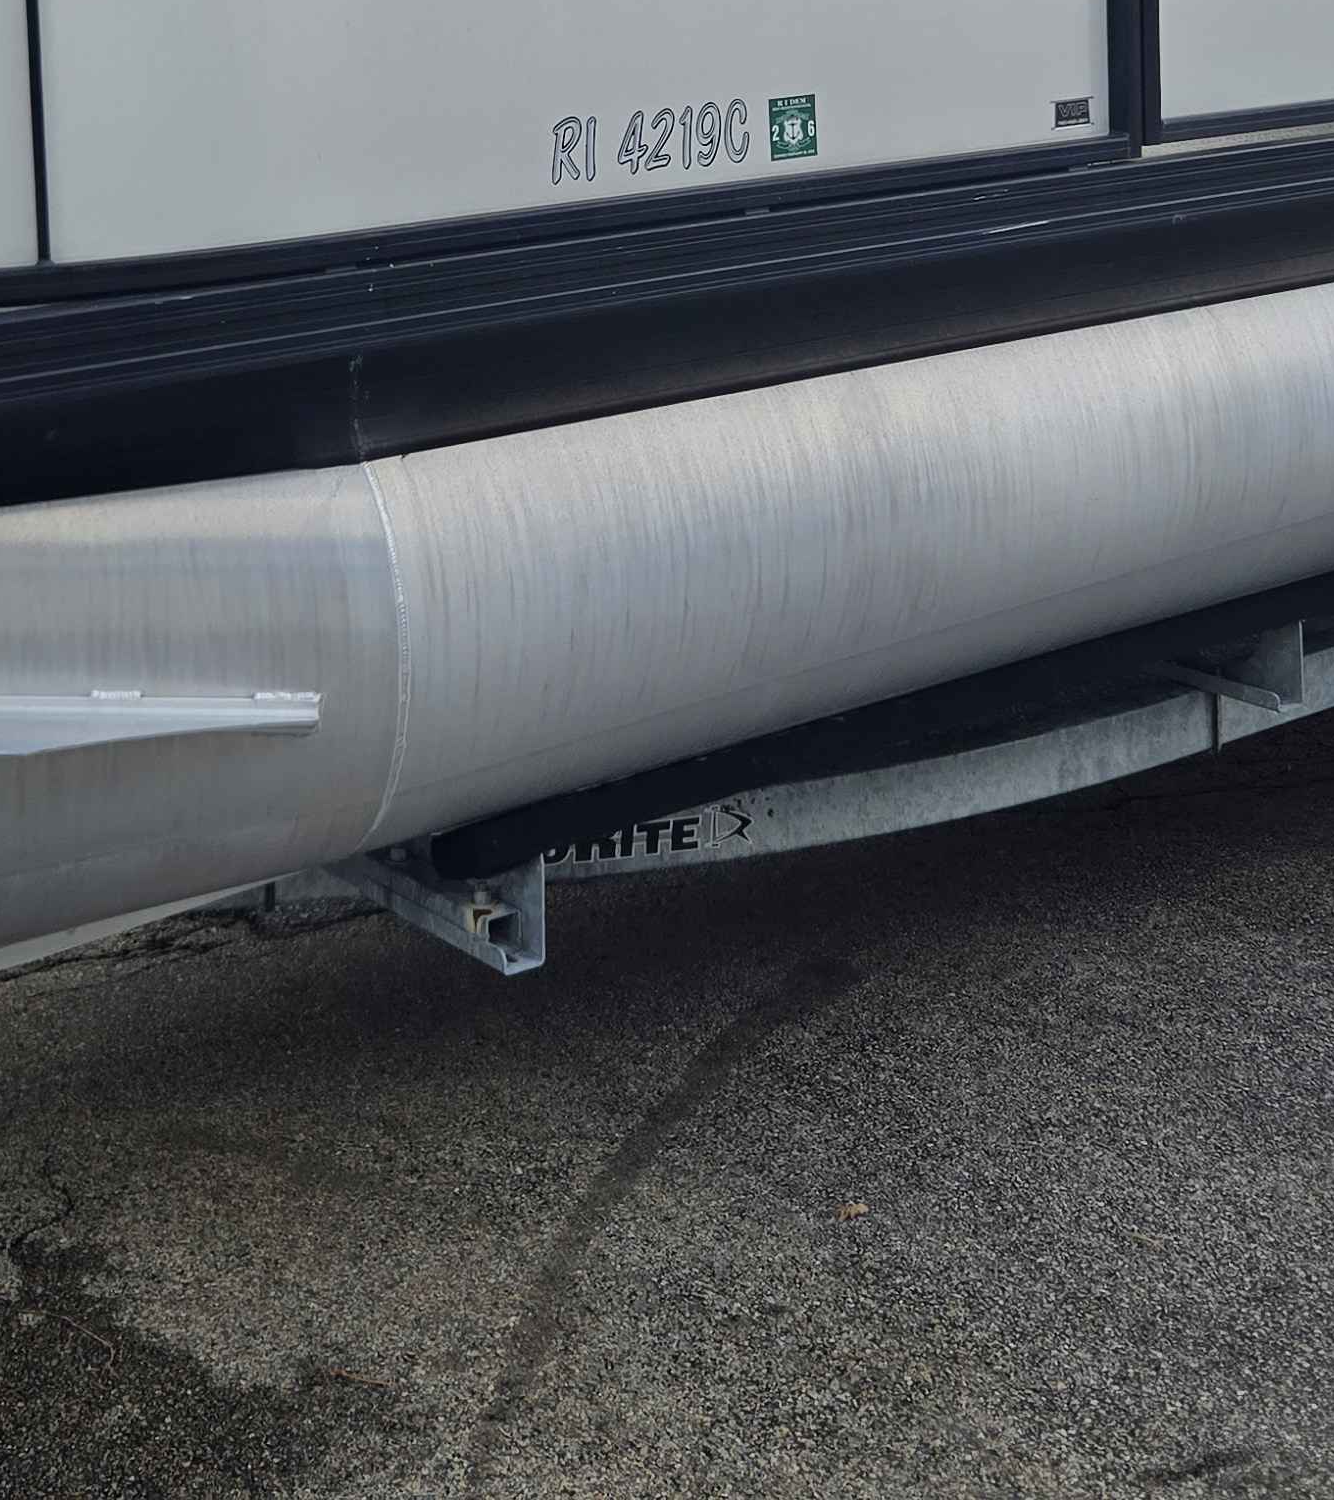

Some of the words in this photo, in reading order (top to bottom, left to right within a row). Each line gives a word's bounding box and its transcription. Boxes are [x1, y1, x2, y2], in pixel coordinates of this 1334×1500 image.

[551, 115, 597, 185] RI
[617, 98, 750, 175] 4219C
[771, 124, 780, 142] 2
[807, 120, 815, 137] 6
